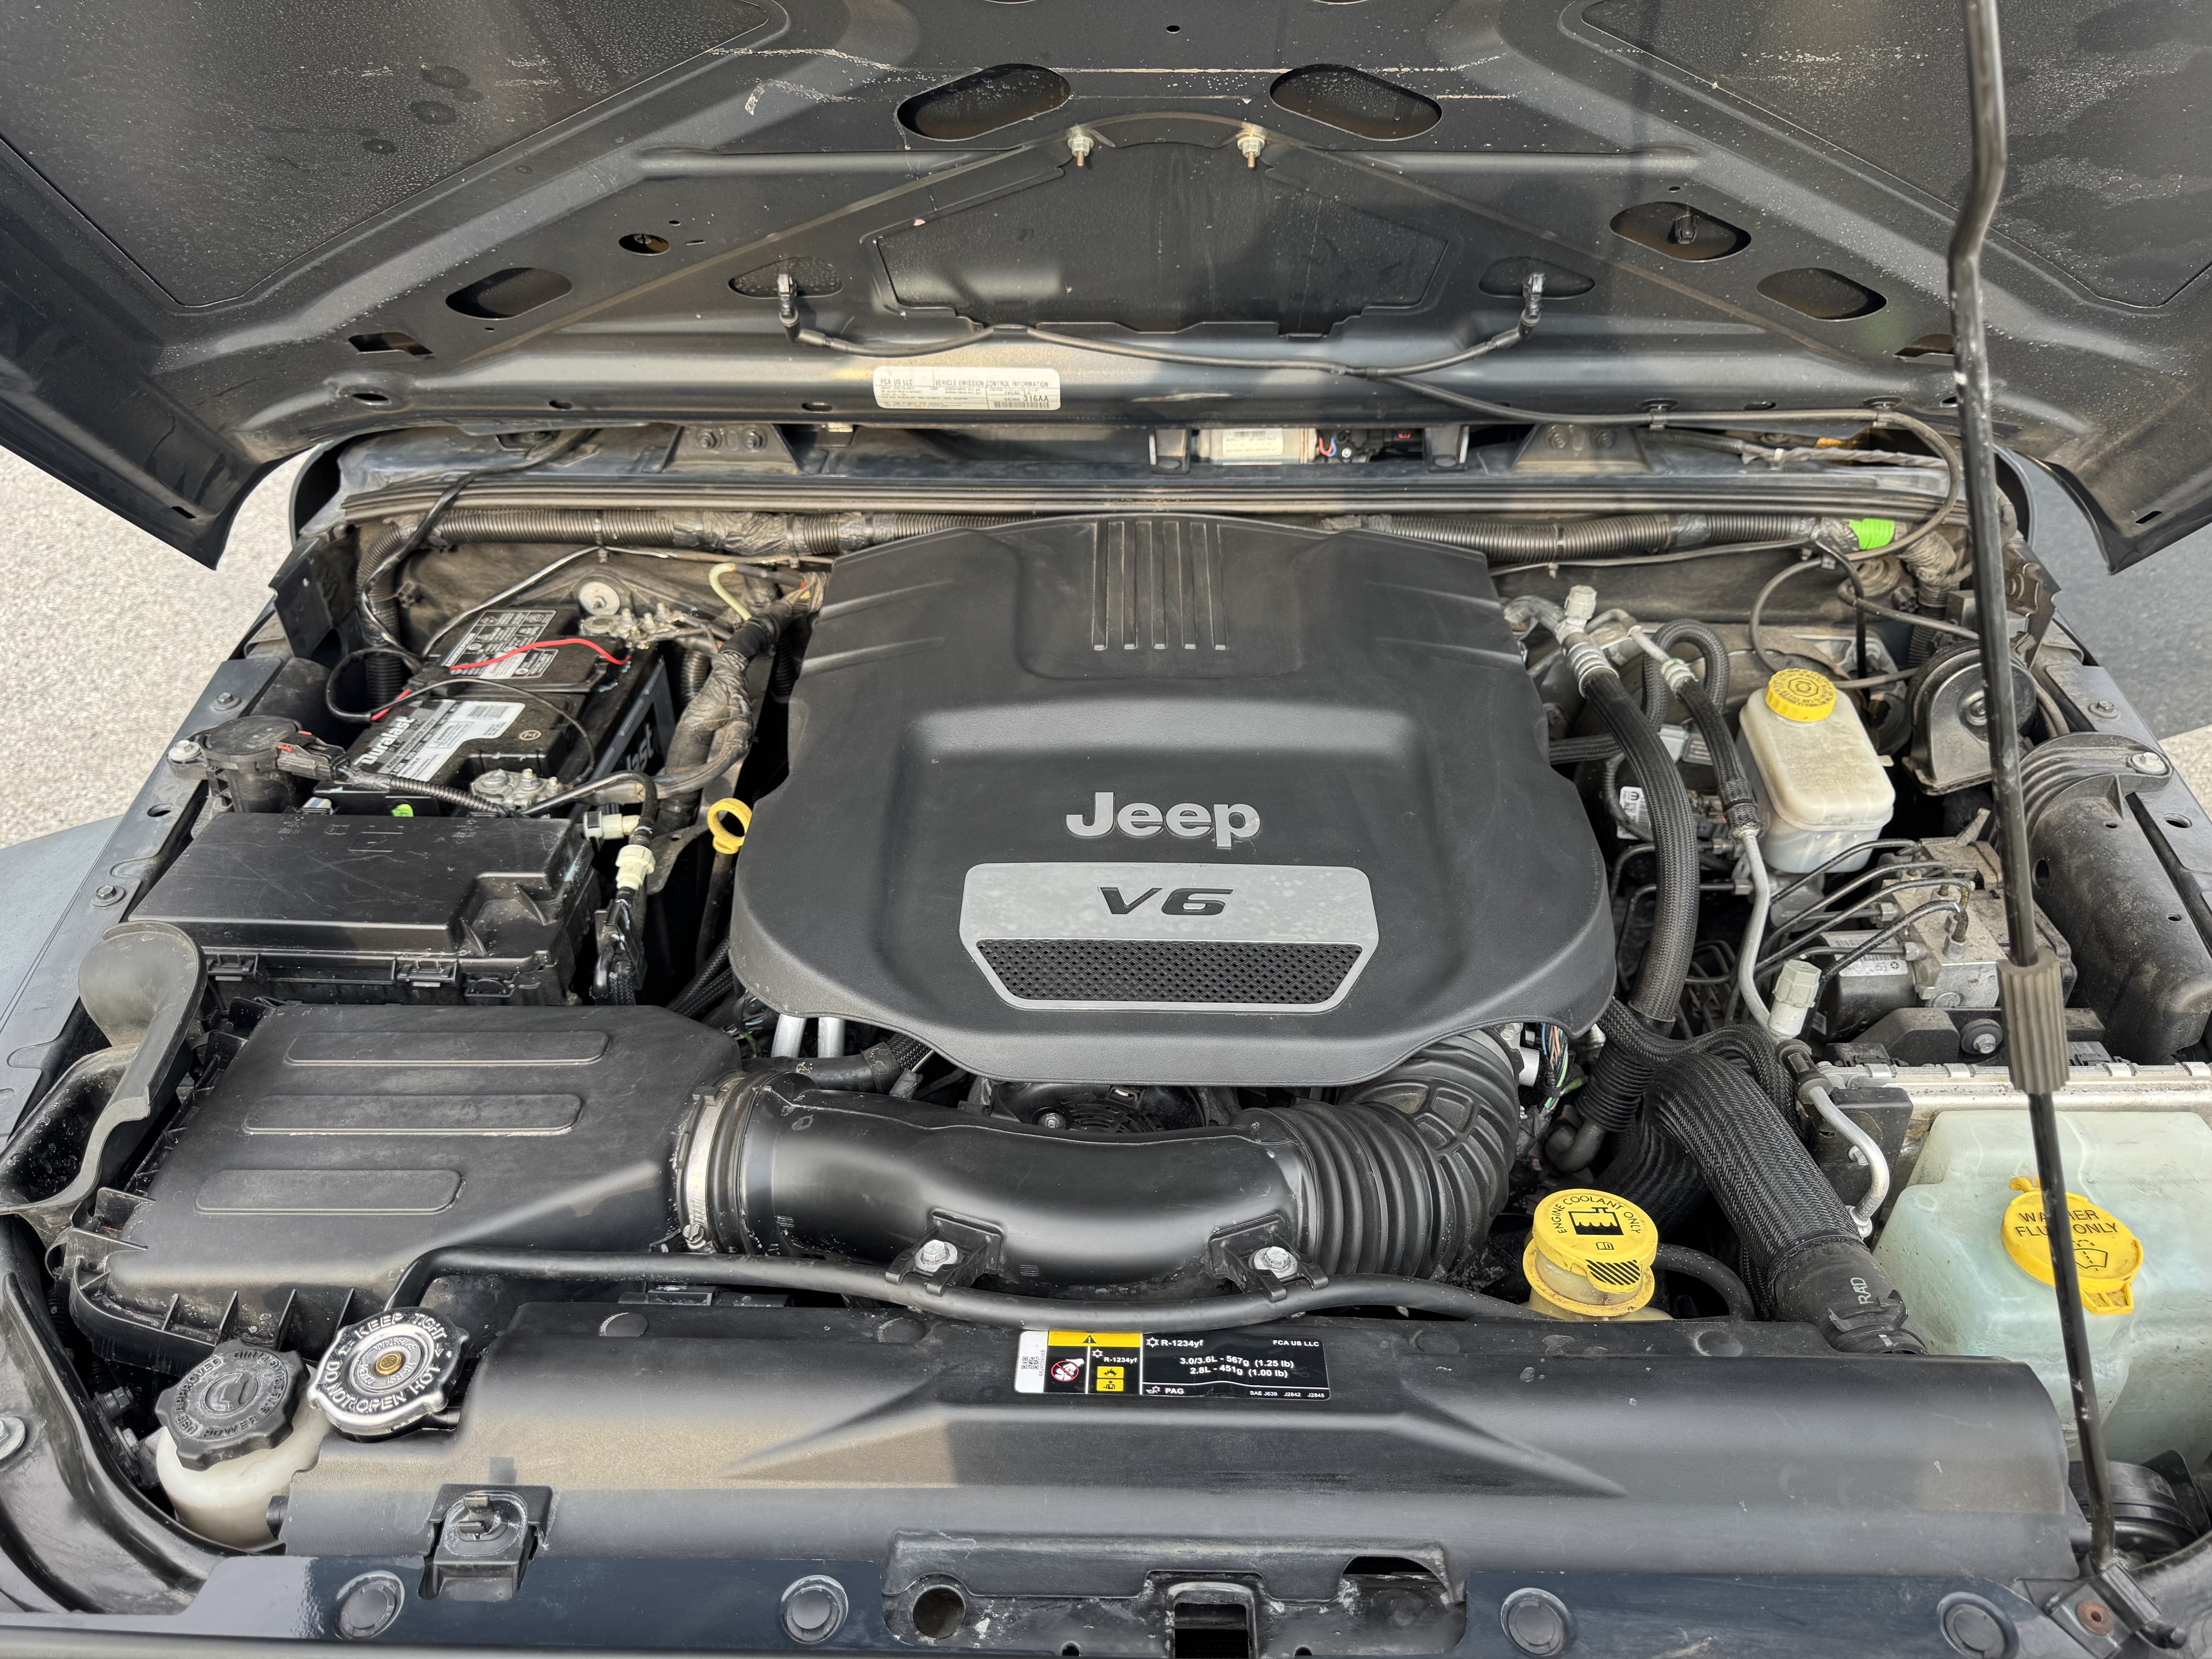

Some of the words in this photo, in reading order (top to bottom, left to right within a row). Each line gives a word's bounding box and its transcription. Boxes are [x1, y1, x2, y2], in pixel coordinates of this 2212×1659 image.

[352, 715, 416, 766] Duralast
[386, 756, 402, 769] AGM
[399, 718, 435, 756] TECHNOLOGY
[1066, 792, 1260, 848] Jeep
[1098, 886, 1234, 915] V6
[1551, 1202, 1567, 1234] ENGINE
[1563, 1195, 1625, 1210] COOLANT
[1623, 1211, 1642, 1234] ONLY
[2018, 1209, 2100, 1223] WAHER
[2073, 1221, 2119, 1235] ONLY
[1850, 1277, 1874, 1305] RAD
[354, 1312, 404, 1340] KEEP
[412, 1312, 448, 1340] TIGHT
[1161, 1339, 1204, 1348] R-1234yf
[324, 1360, 342, 1383] DO
[1180, 1355, 1218, 1365] 3.0/3.6L
[1226, 1355, 1250, 1367] 567g
[1254, 1359, 1279, 1368] (1.25
[1281, 1360, 1294, 1369] lb)
[1219, 1364, 1243, 1376] 451g
[1248, 1369, 1273, 1377] (1.00
[1274, 1369, 1288, 1378] lb)
[174, 1356, 223, 1412] APPROVED
[409, 1365, 441, 1395] HOT
[203, 1415, 259, 1437] POWER
[260, 1358, 286, 1414] STEERING
[326, 1382, 357, 1408] NOT
[356, 1391, 407, 1413] OPEN
[175, 1413, 199, 1435] USE
